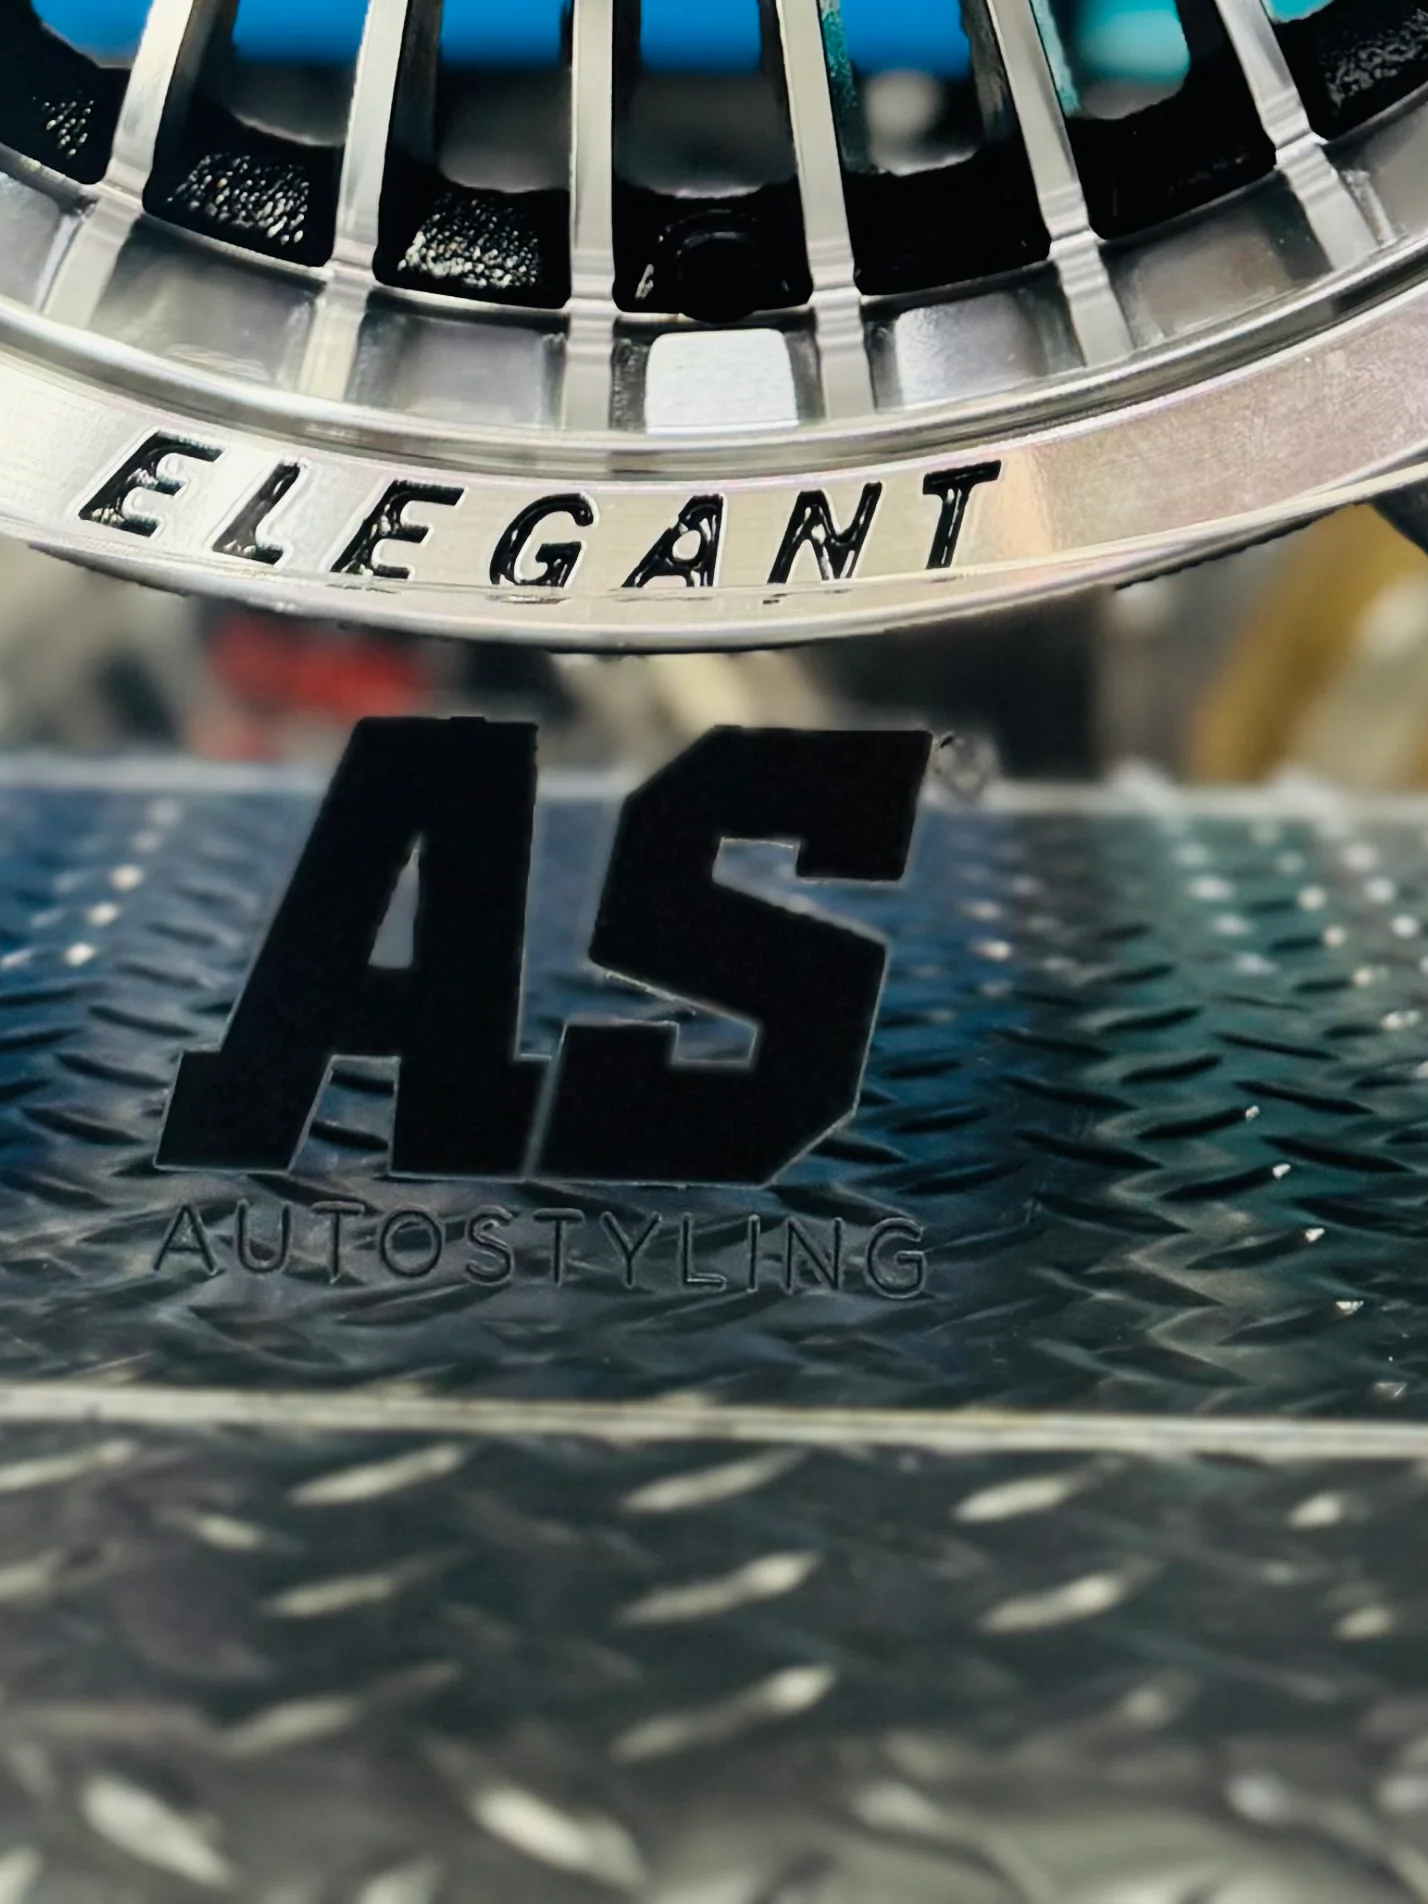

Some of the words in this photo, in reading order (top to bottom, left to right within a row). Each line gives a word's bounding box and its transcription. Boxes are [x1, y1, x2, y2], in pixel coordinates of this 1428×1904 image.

[78, 431, 1002, 590] ELEGANT
[153, 716, 933, 1190] AS
[153, 1199, 930, 1300] AUTOSTYLING
